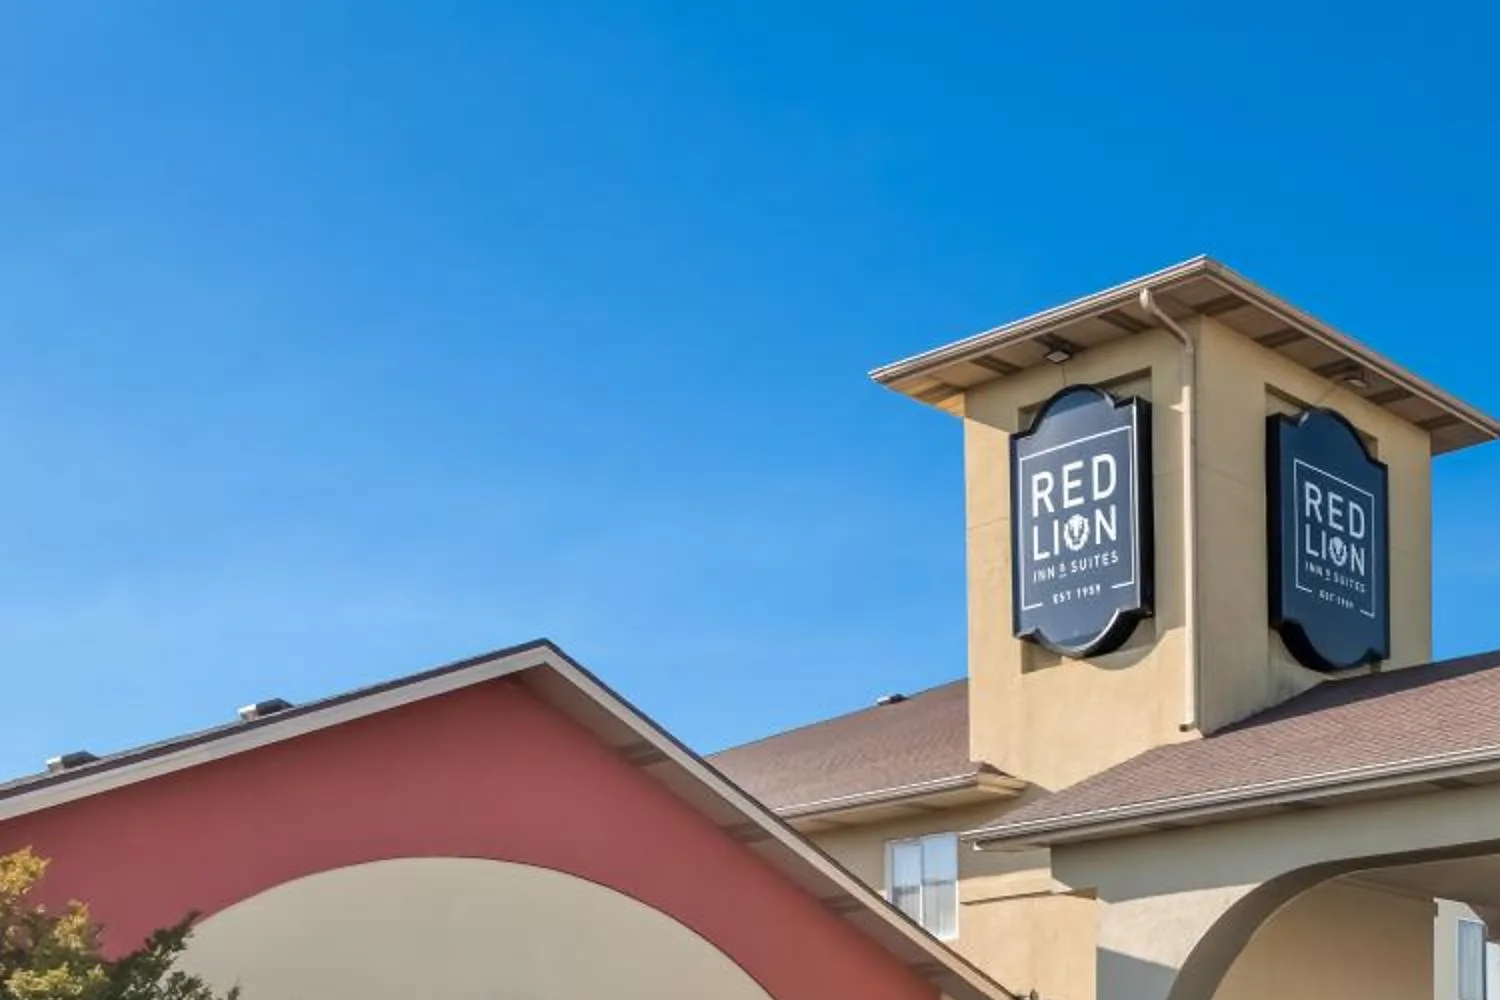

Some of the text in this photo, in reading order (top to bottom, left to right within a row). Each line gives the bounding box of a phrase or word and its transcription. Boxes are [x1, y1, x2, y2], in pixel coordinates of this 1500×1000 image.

[1031, 453, 1117, 518] RED
[1304, 481, 1366, 540] RED
[1032, 504, 1117, 561] LION
[1305, 523, 1365, 578] LION
[1033, 565, 1055, 583] INN
[1071, 550, 1119, 573] SUITES
